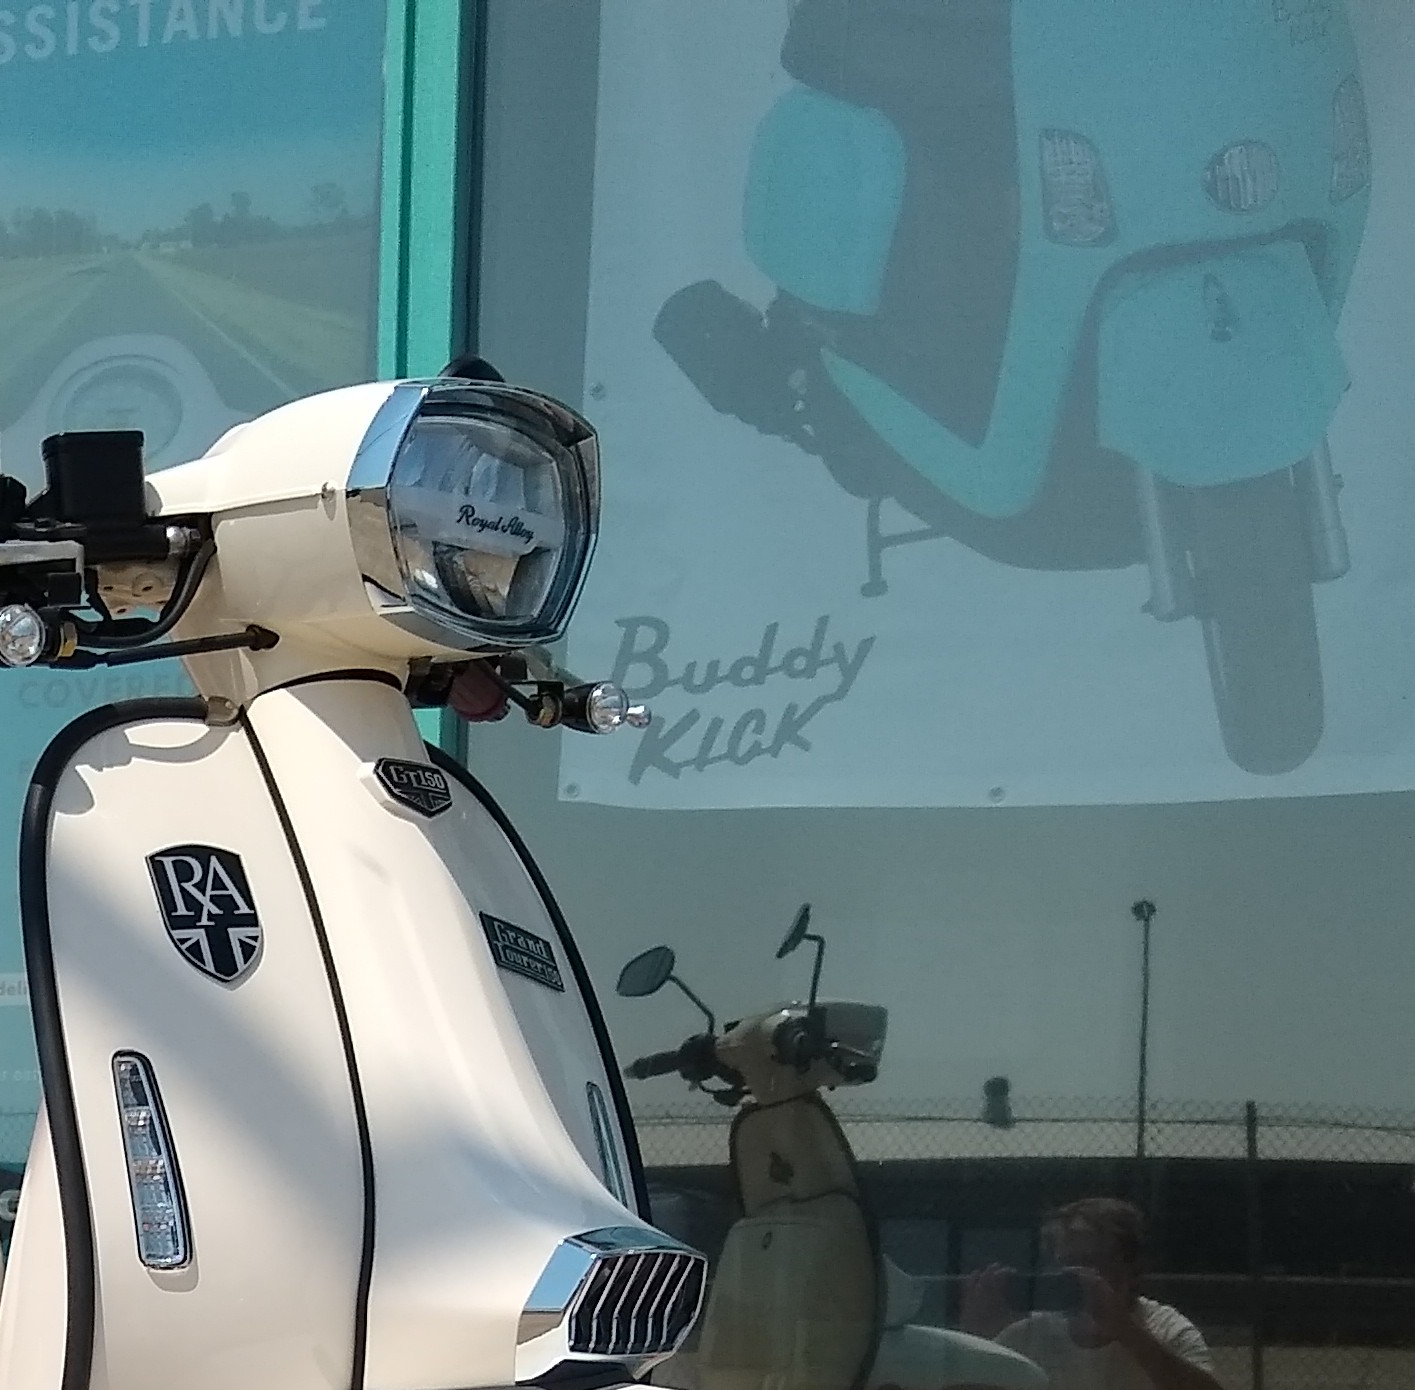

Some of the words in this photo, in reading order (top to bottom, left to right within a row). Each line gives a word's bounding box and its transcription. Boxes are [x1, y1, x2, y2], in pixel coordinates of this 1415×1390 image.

[456, 504, 504, 533] Royal
[501, 516, 535, 544] Alloy
[612, 613, 877, 701] Buddy
[628, 698, 826, 786] KICK
[388, 764, 446, 791] GT150
[154, 855, 255, 926] RA
[492, 920, 550, 960] Grand
